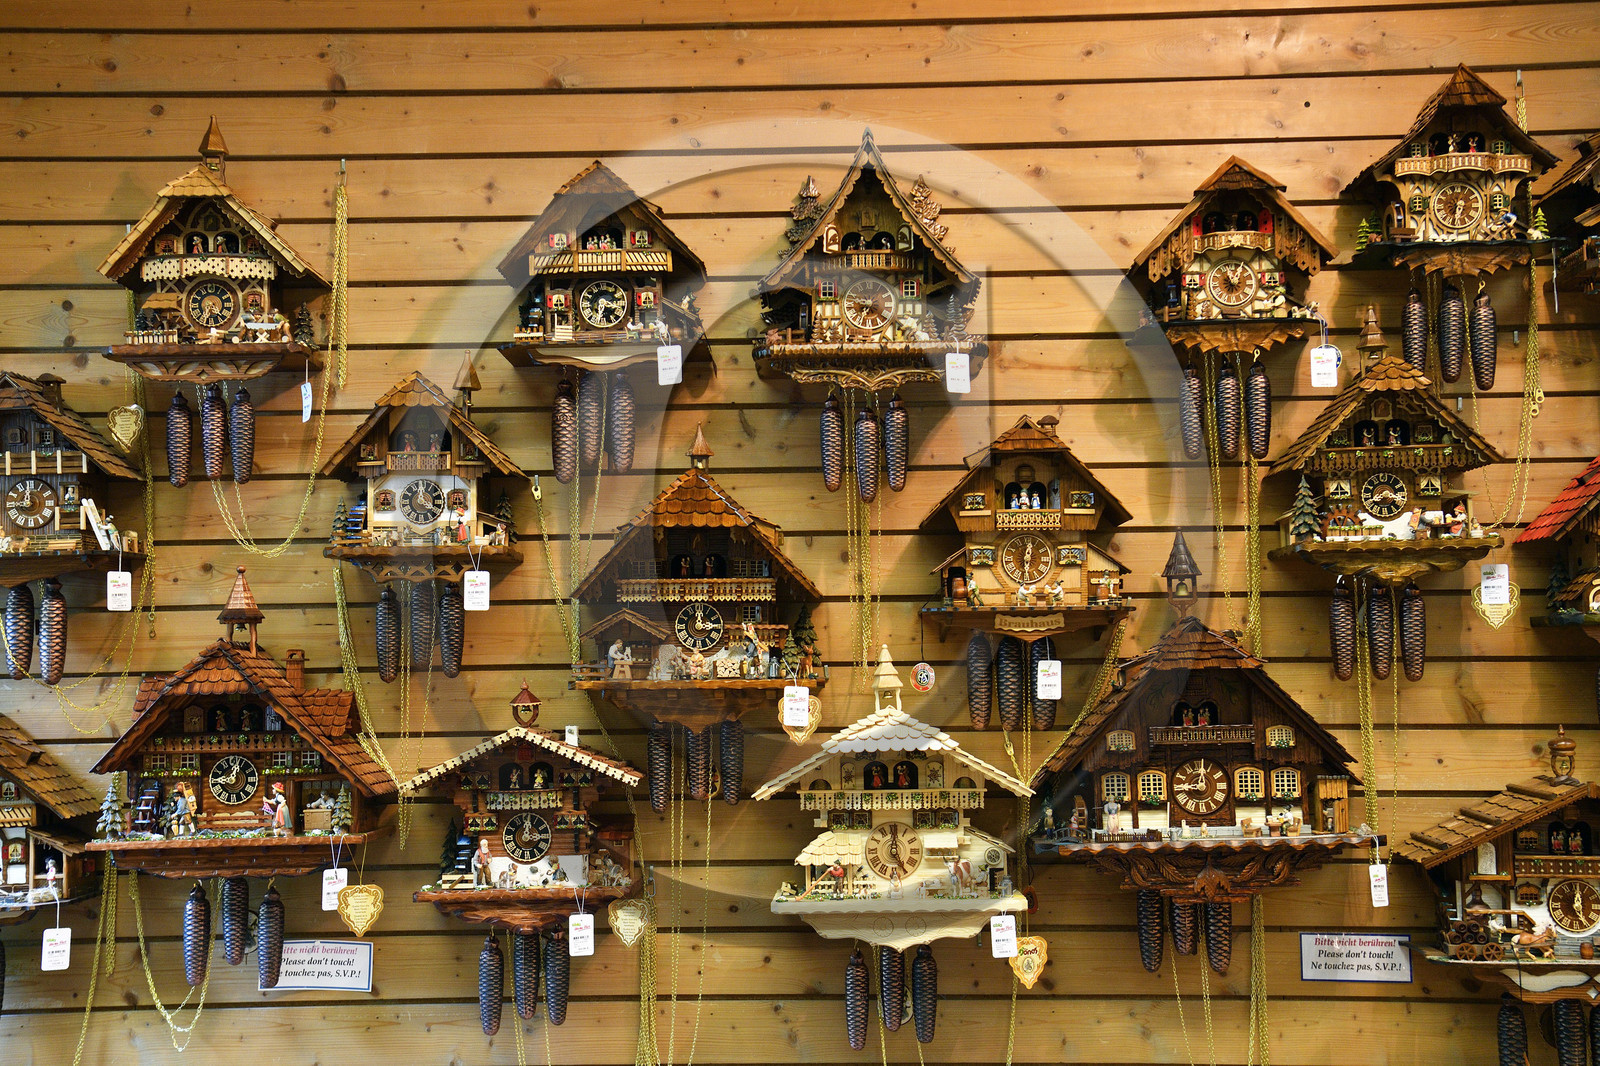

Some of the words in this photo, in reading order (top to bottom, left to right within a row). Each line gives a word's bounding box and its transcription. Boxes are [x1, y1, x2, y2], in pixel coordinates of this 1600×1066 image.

[998, 618, 1061, 629] Brauhaus
[1314, 938, 1334, 946] Bitte
[1358, 939, 1396, 947] berühren!
[282, 946, 298, 955] itte
[300, 946, 320, 954] nicht
[322, 946, 358, 955] berühren!
[1318, 950, 1344, 958] Please
[1346, 950, 1366, 958] don't
[307, 957, 328, 966] don't
[1324, 962, 1354, 970] touchez
[1356, 964, 1373, 972] pas,
[1375, 962, 1402, 971] S.V.P.!
[317, 970, 333, 978] pas,
[335, 970, 361, 978] S.V.P.!
